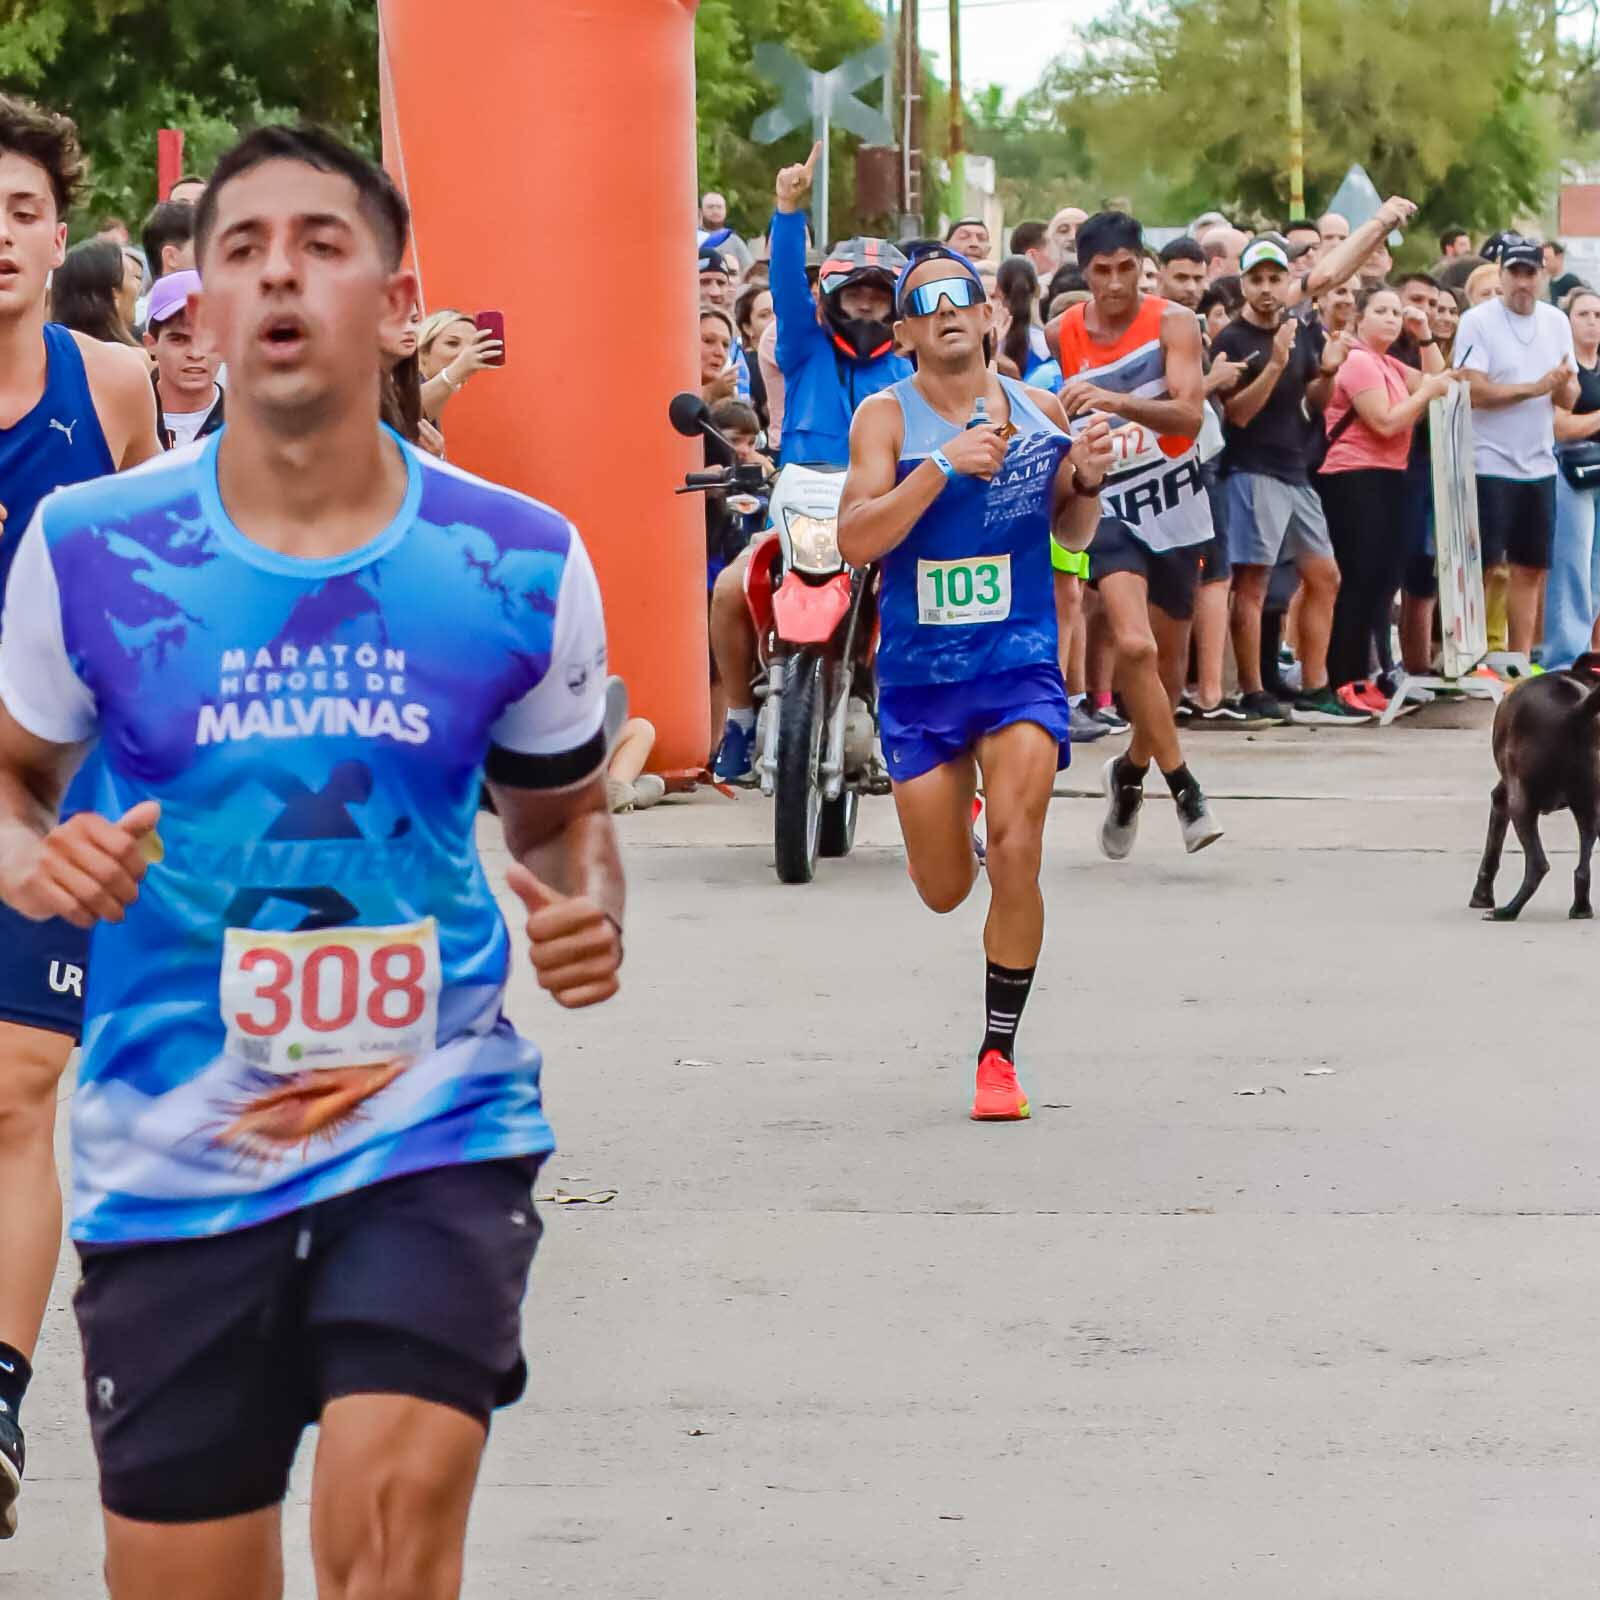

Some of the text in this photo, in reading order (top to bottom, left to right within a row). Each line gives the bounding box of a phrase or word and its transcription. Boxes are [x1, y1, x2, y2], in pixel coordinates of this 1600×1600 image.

[926, 564, 1001, 608] 103
[365, 673, 407, 695] DE
[196, 697, 431, 745] MALVINAS
[235, 943, 426, 1036] 308
